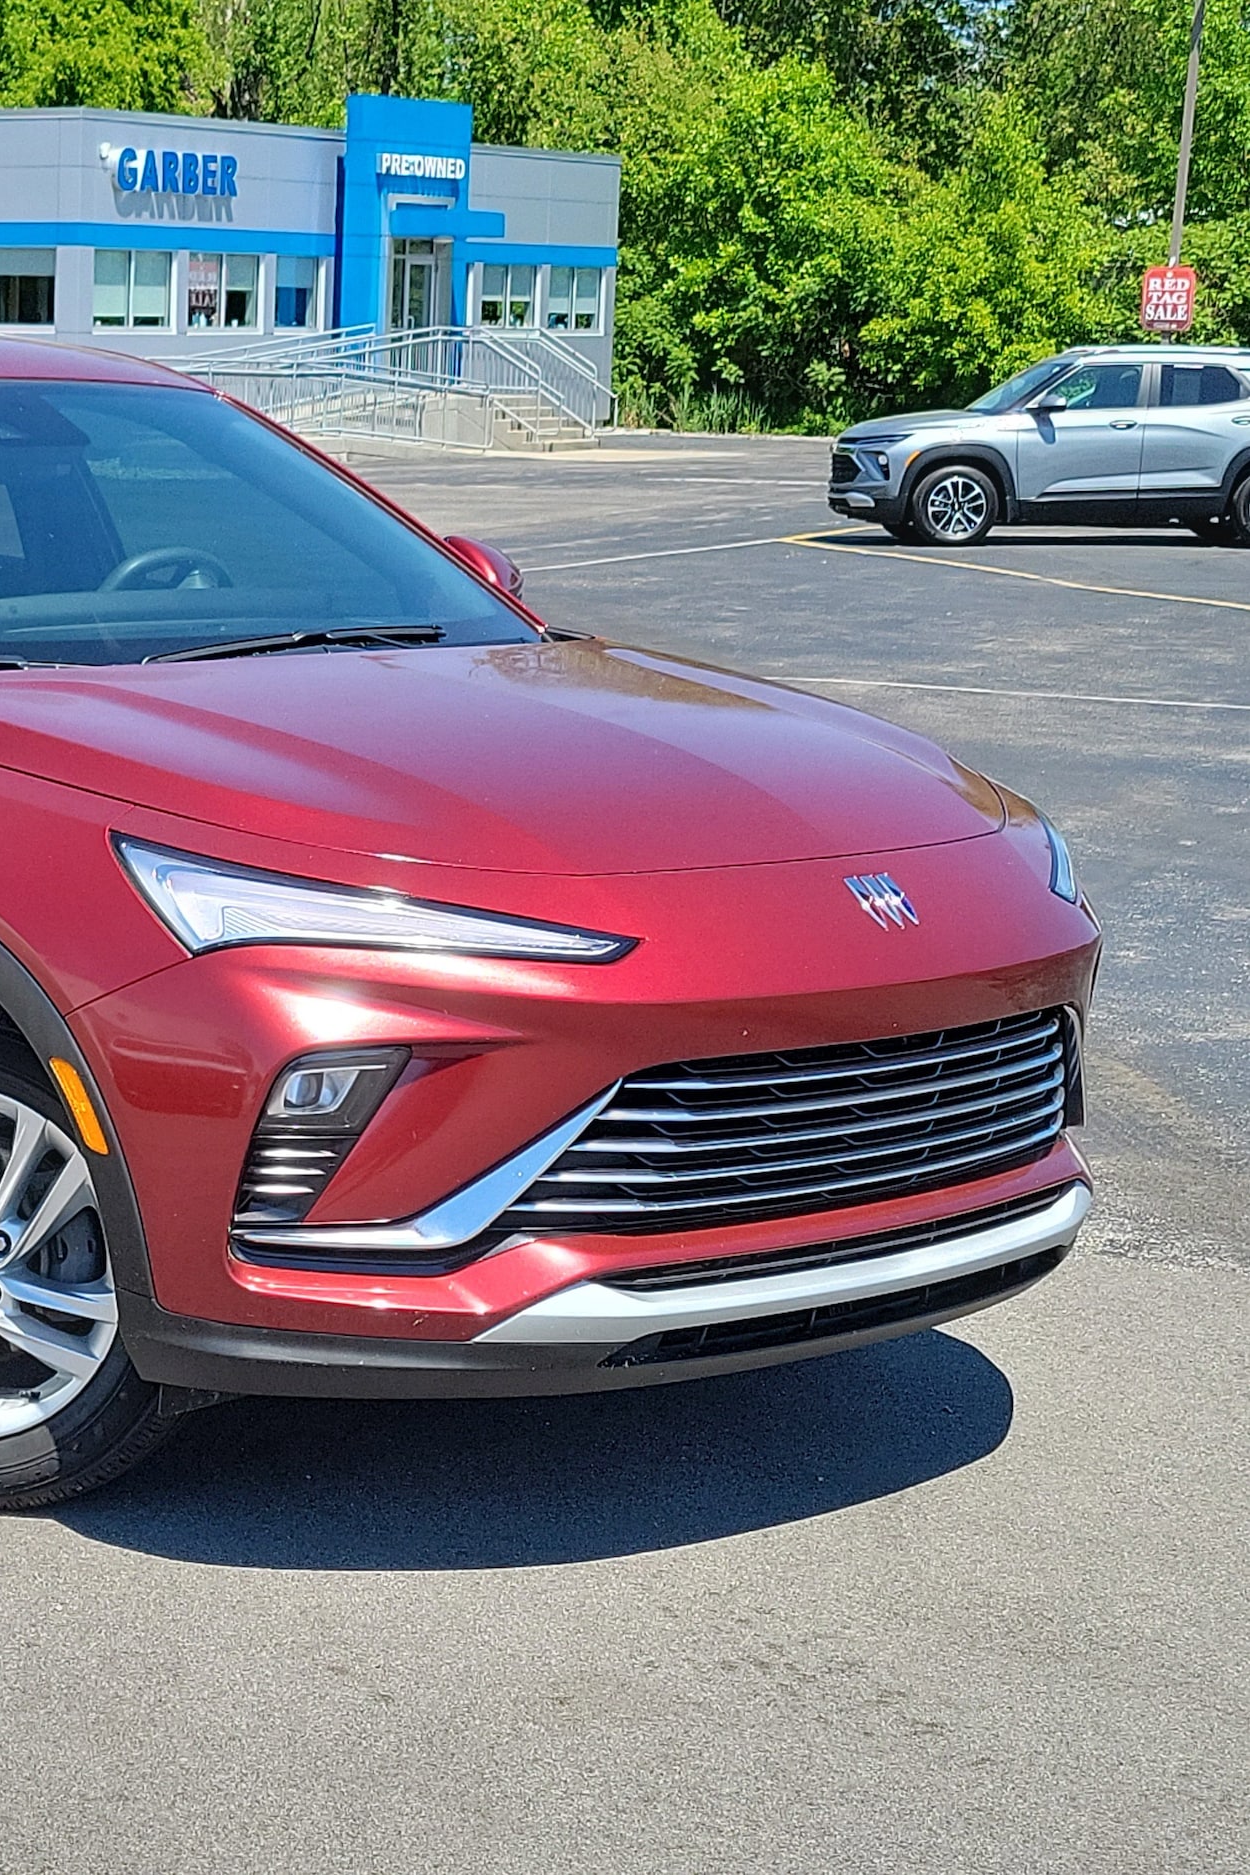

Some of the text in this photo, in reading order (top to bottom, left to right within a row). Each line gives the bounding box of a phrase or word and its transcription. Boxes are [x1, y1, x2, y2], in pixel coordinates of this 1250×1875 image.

[117, 147, 237, 197] GARBER
[1148, 278, 1190, 291] RED
[1148, 292, 1188, 304] TAG
[1144, 305, 1188, 320] SALE
